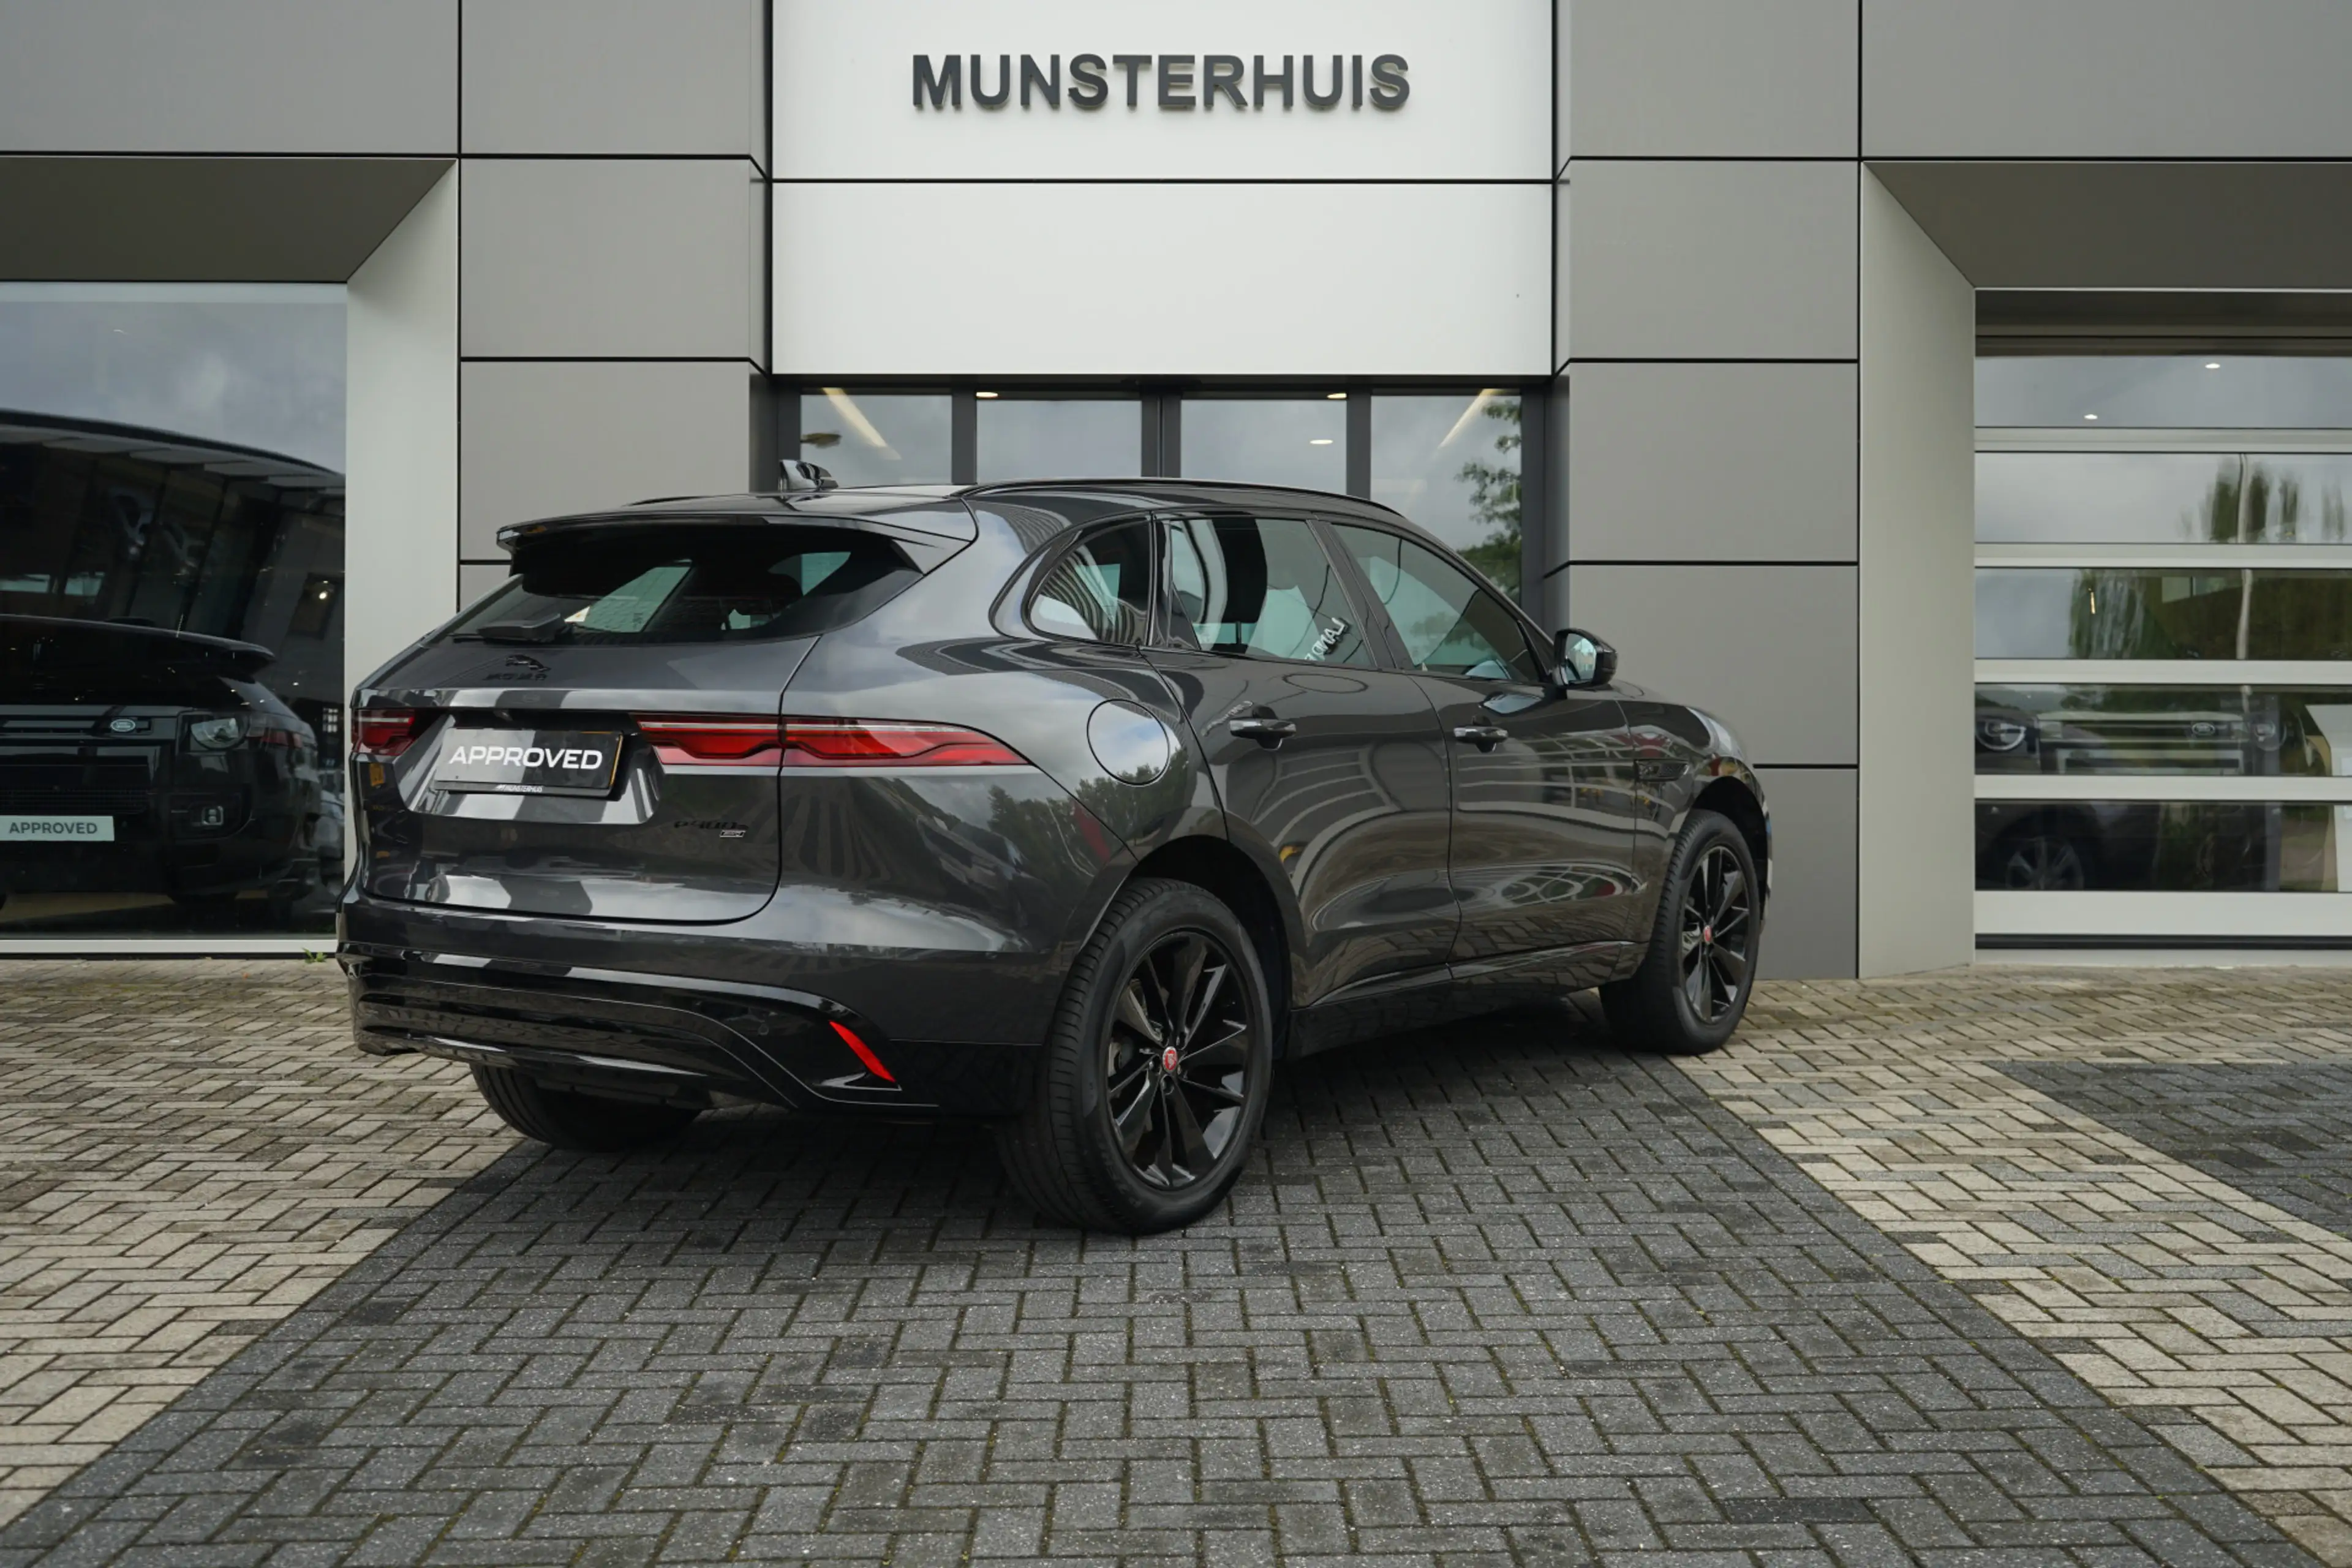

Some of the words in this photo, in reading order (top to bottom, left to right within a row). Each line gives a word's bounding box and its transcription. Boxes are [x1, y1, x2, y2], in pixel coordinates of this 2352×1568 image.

[913, 53, 1410, 108] MUNSTERHUIS
[448, 746, 603, 769] APPROVED
[9, 821, 98, 834] APPROVED
